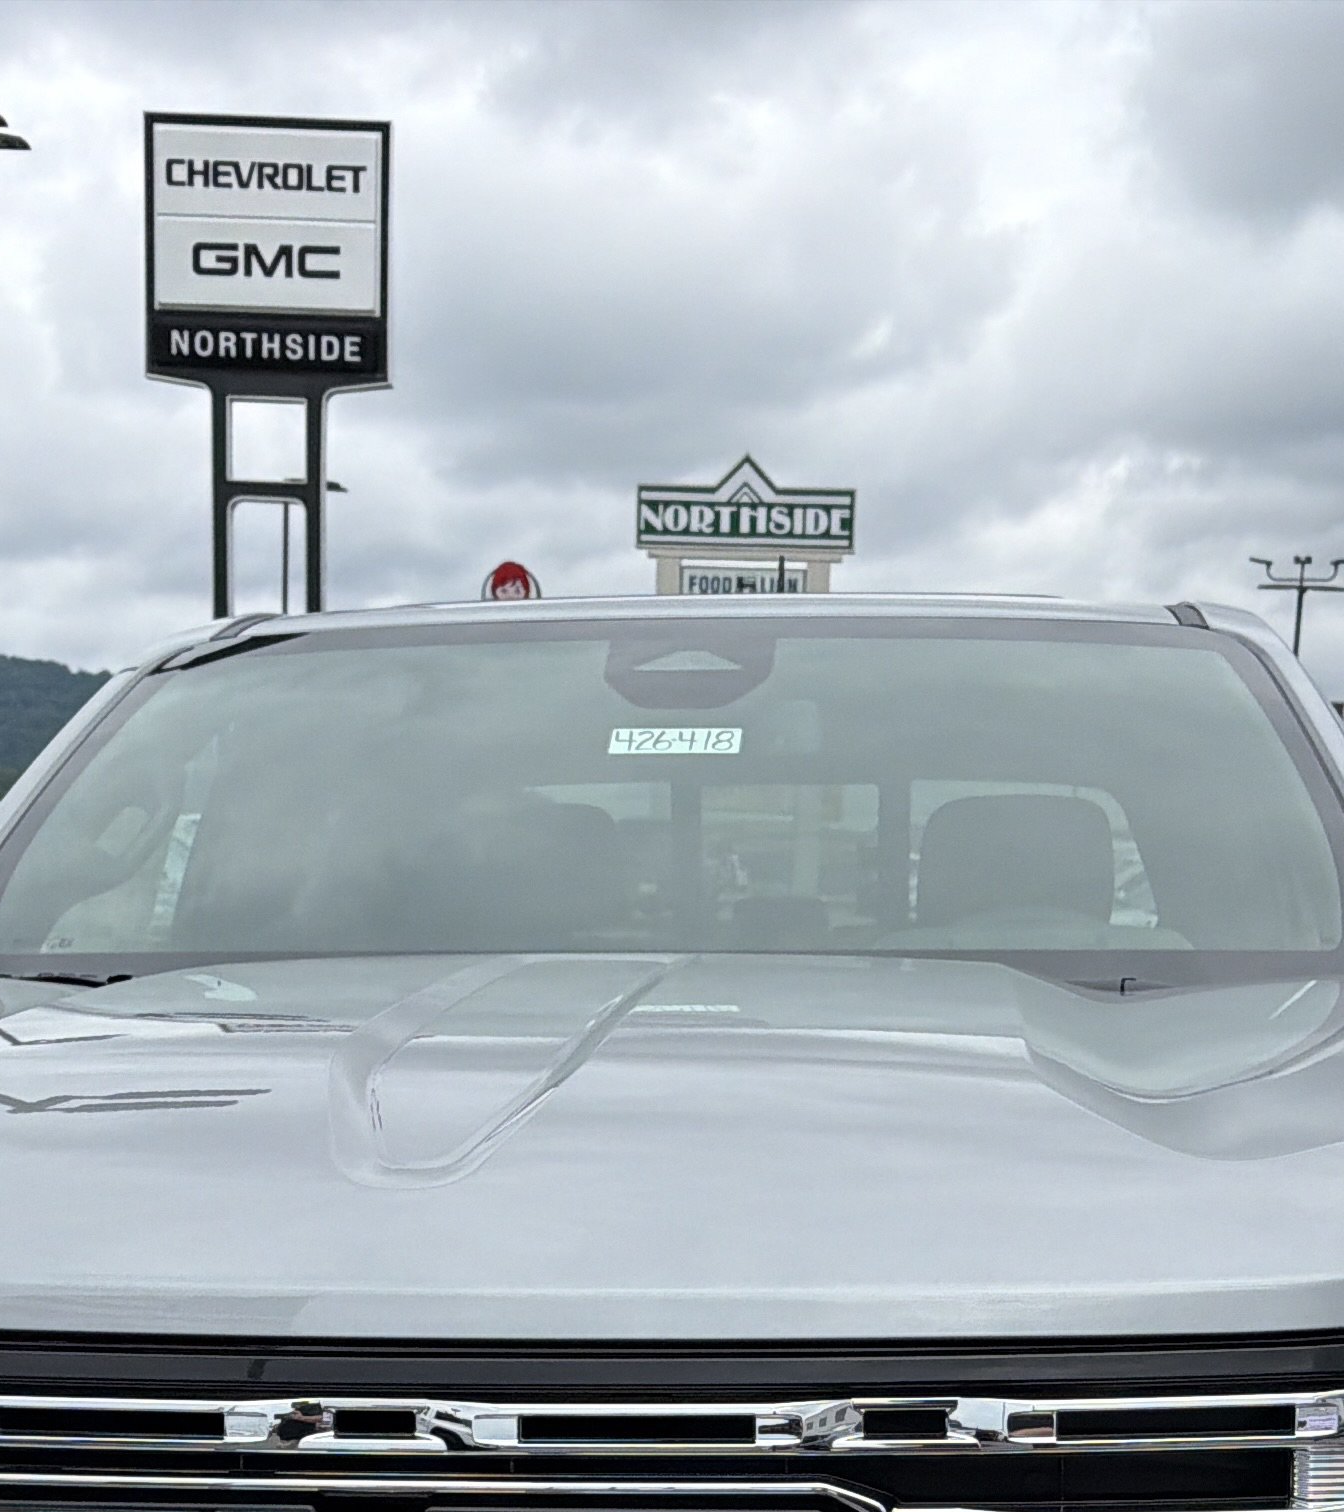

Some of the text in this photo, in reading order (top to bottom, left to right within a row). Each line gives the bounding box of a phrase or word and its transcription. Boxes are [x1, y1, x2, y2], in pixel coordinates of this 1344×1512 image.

[165, 158, 367, 194] CHEVROLET
[192, 242, 341, 280] GMC
[169, 329, 362, 363] NORTHSIDE
[640, 503, 850, 536] NORTHSIDE
[689, 575, 798, 594] FOOD LIN
